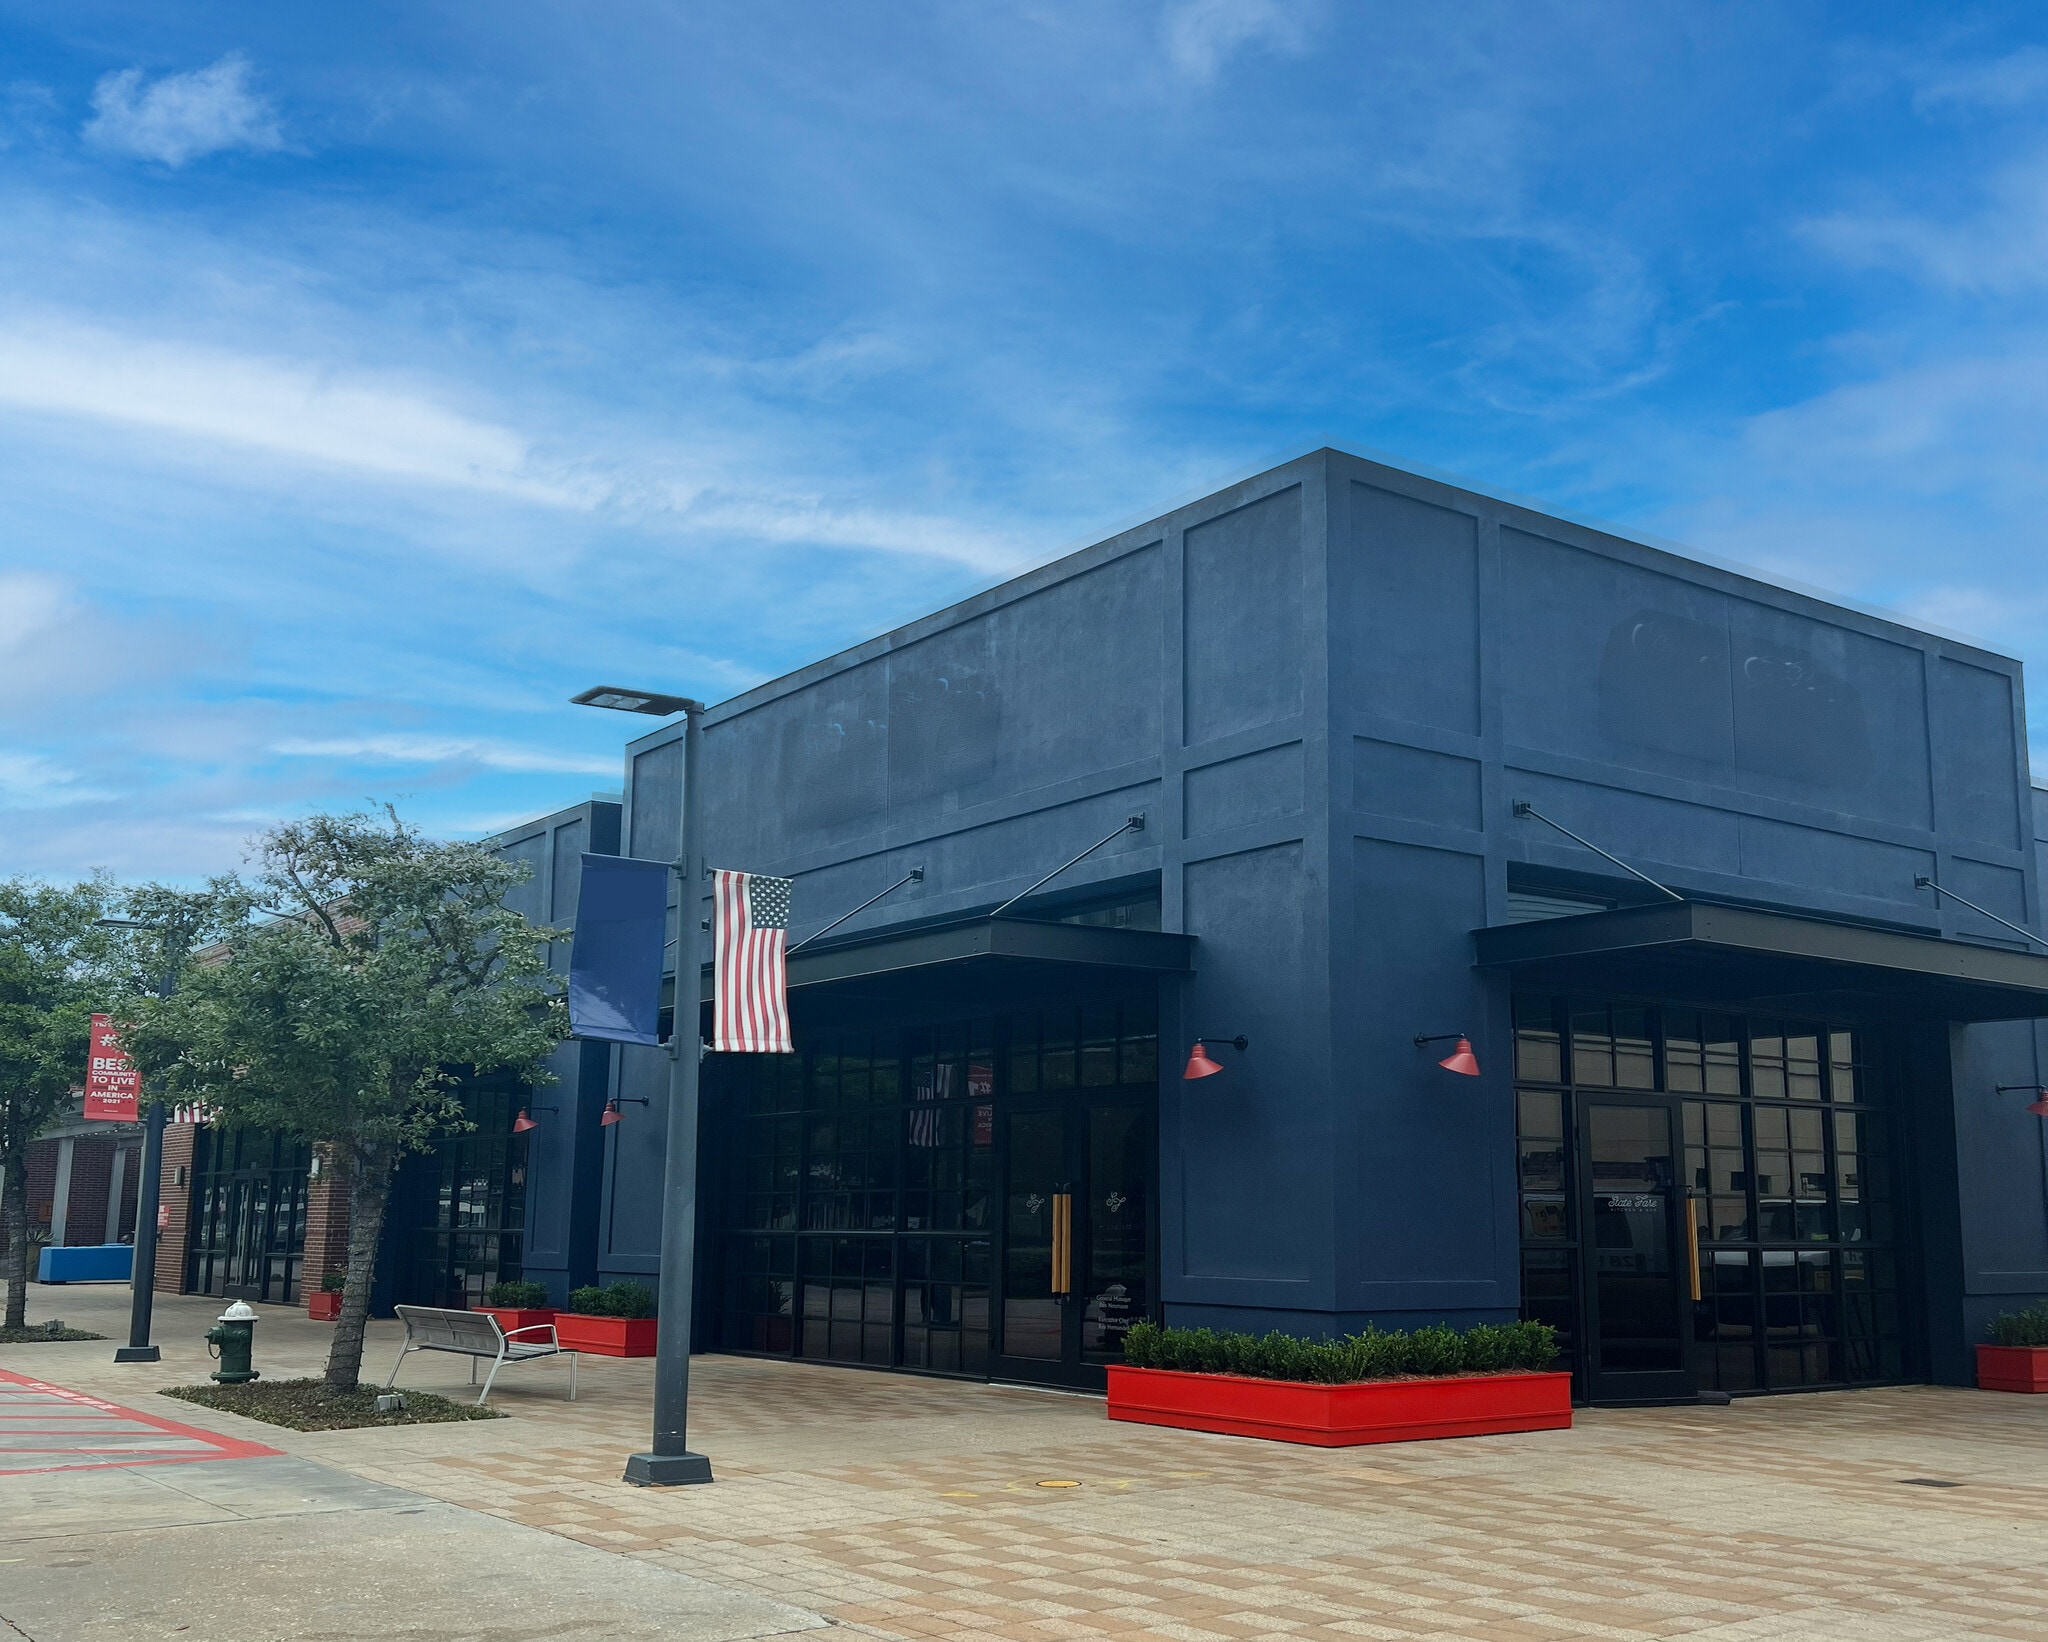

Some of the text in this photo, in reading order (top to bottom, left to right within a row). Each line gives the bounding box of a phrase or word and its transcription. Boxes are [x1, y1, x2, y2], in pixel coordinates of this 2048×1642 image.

[92, 1057, 134, 1071] BES
[111, 1077, 135, 1085] LIVE
[90, 1091, 133, 1099] AMERICA
[1608, 1195, 1658, 1207] State Fare
